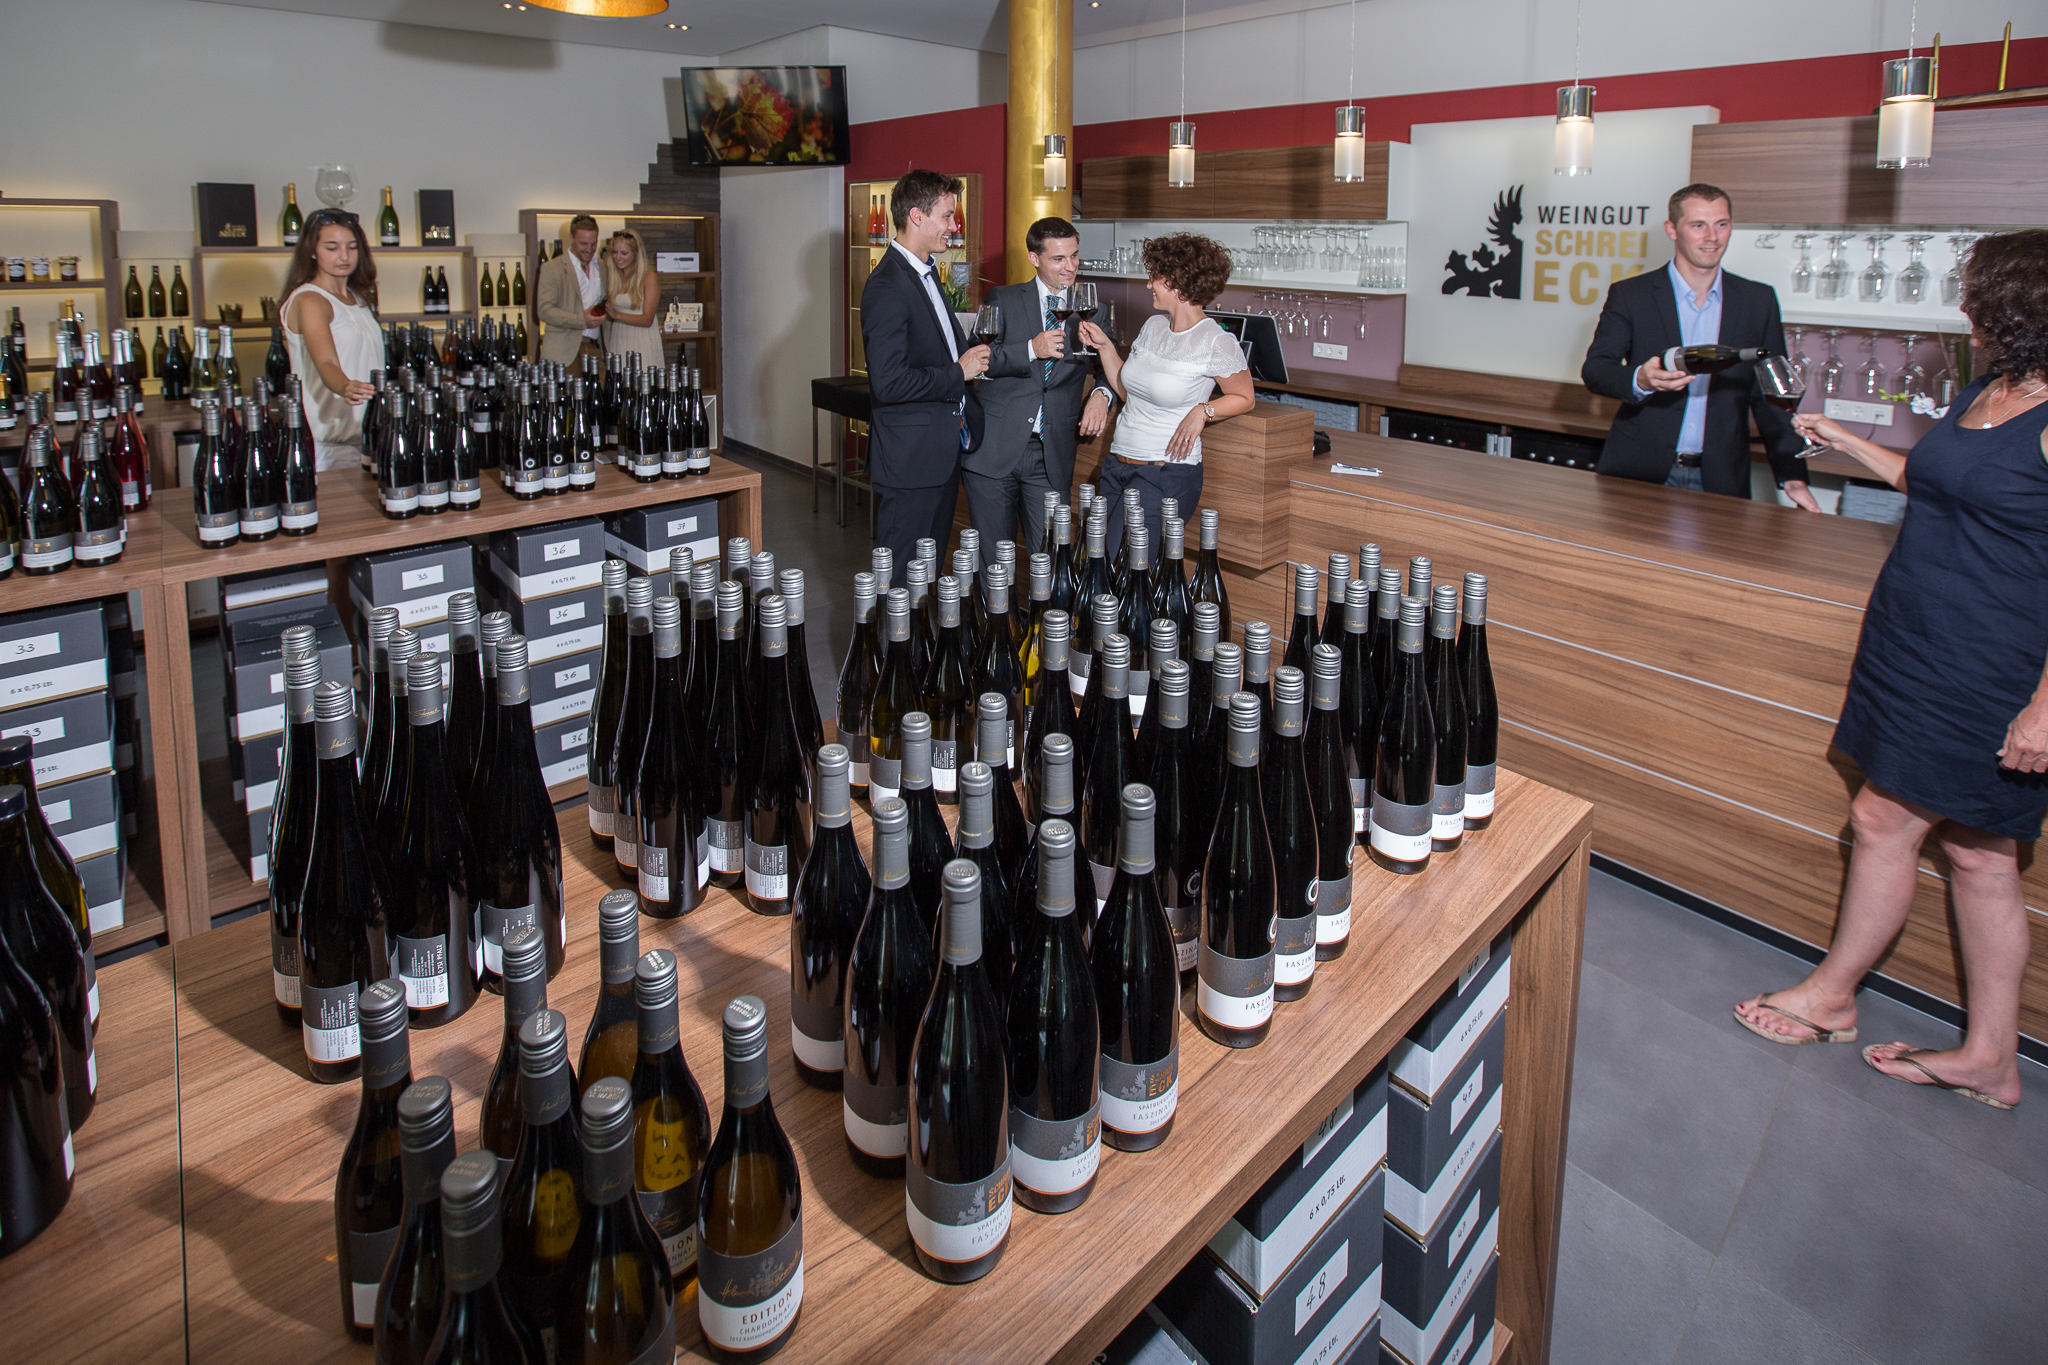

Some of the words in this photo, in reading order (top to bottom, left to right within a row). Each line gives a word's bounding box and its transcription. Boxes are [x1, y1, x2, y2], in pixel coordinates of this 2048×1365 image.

[1538, 205, 1650, 225] WEINGUT
[1535, 229, 1648, 259] SCHREI
[552, 544, 566, 556] 36
[416, 572, 428, 580] 35
[556, 609, 568, 619] 36
[15, 644, 36, 654] 33
[564, 670, 577, 681] 36
[571, 732, 584, 744] 36
[348, 992, 356, 1009] PFALZ
[1149, 1072, 1173, 1097] ECK
[1462, 1082, 1473, 1104] 47
[1309, 1208, 1314, 1220] 6
[1315, 1204, 1320, 1214] x
[1320, 1184, 1335, 1206] 0,75
[1306, 1271, 1327, 1310] 48
[742, 1288, 792, 1325] EDITION
[739, 1303, 791, 1335] CHARDONNAY
[1328, 1334, 1339, 1351] Ltr.
